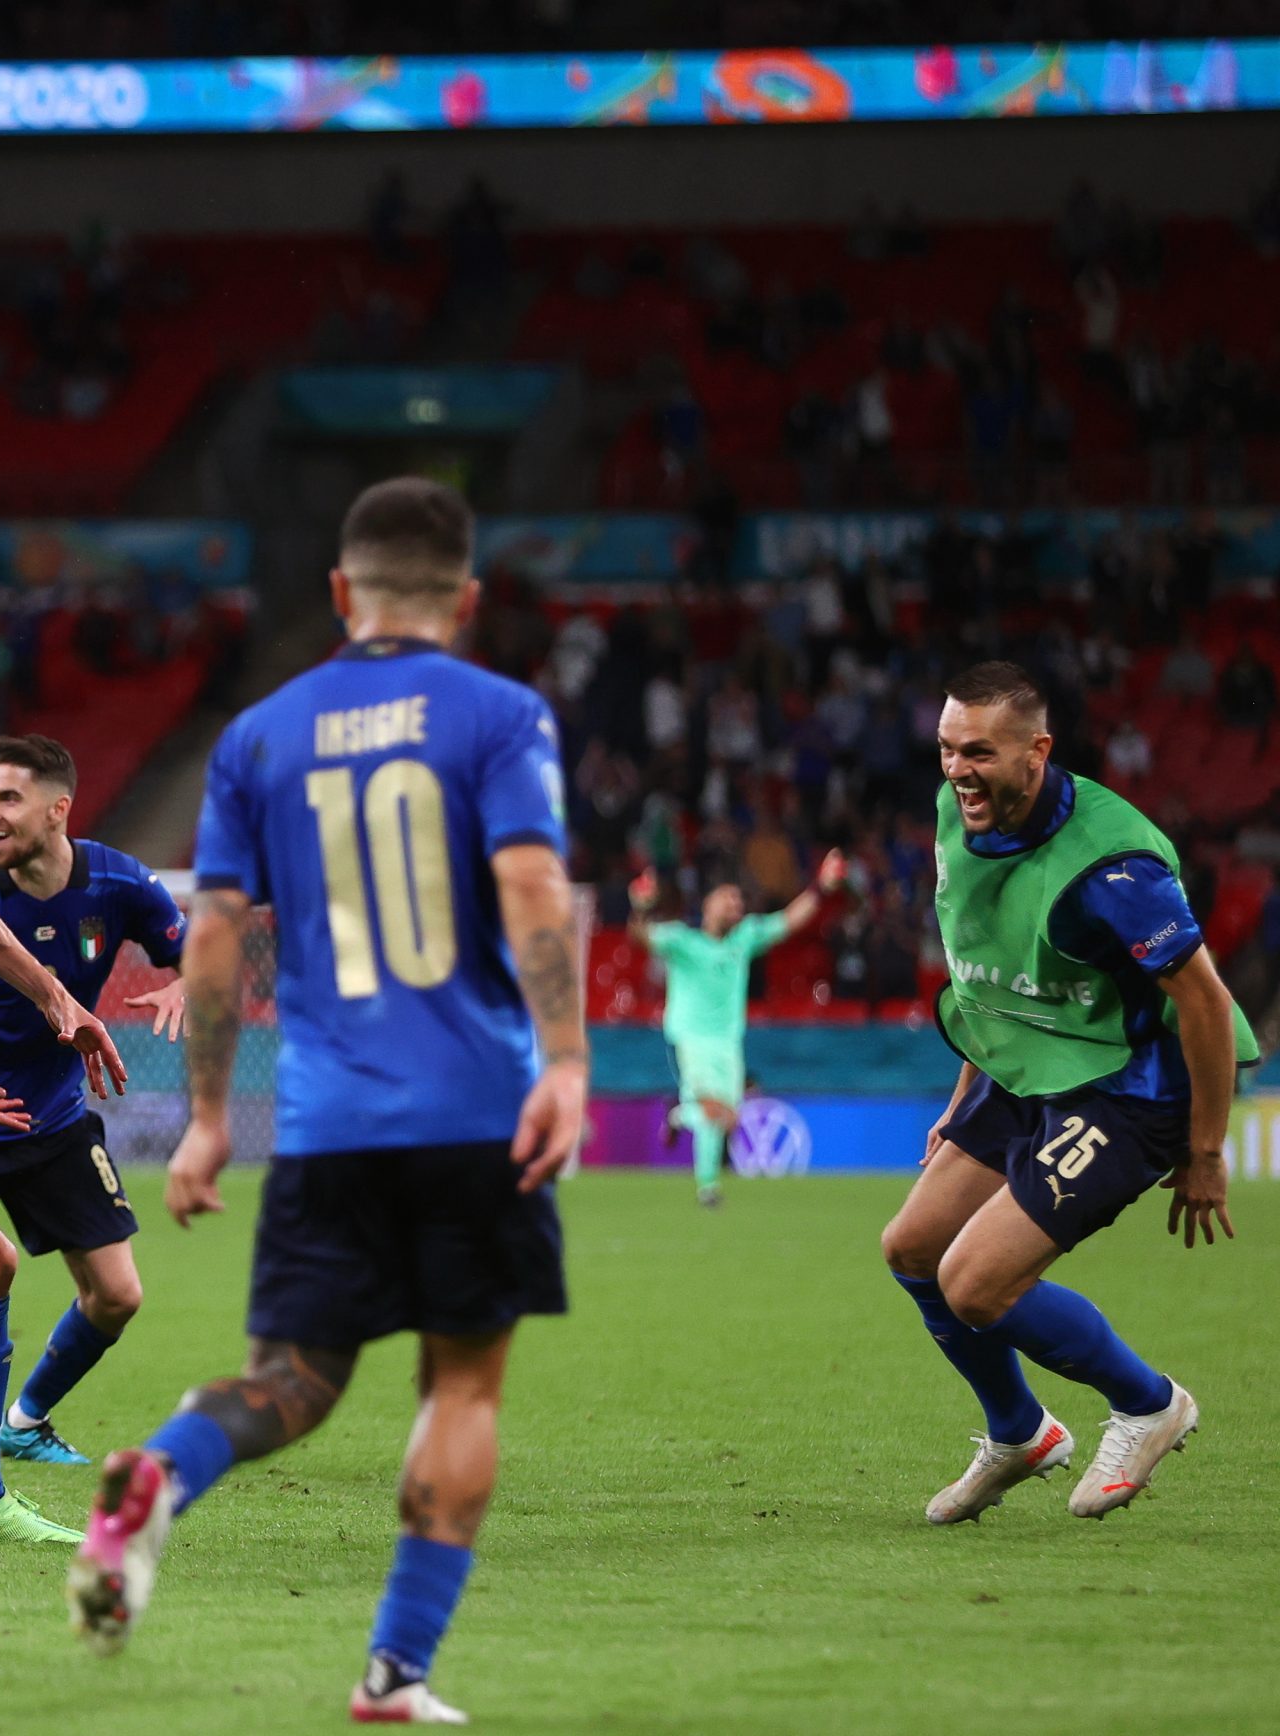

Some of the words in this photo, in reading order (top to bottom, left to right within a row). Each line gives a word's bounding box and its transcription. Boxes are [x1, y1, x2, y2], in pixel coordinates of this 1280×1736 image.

[305, 758, 456, 998] 10
[1144, 921, 1178, 950] RESPECT
[90, 1144, 119, 1195] 8
[1035, 1115, 1109, 1180] 25
